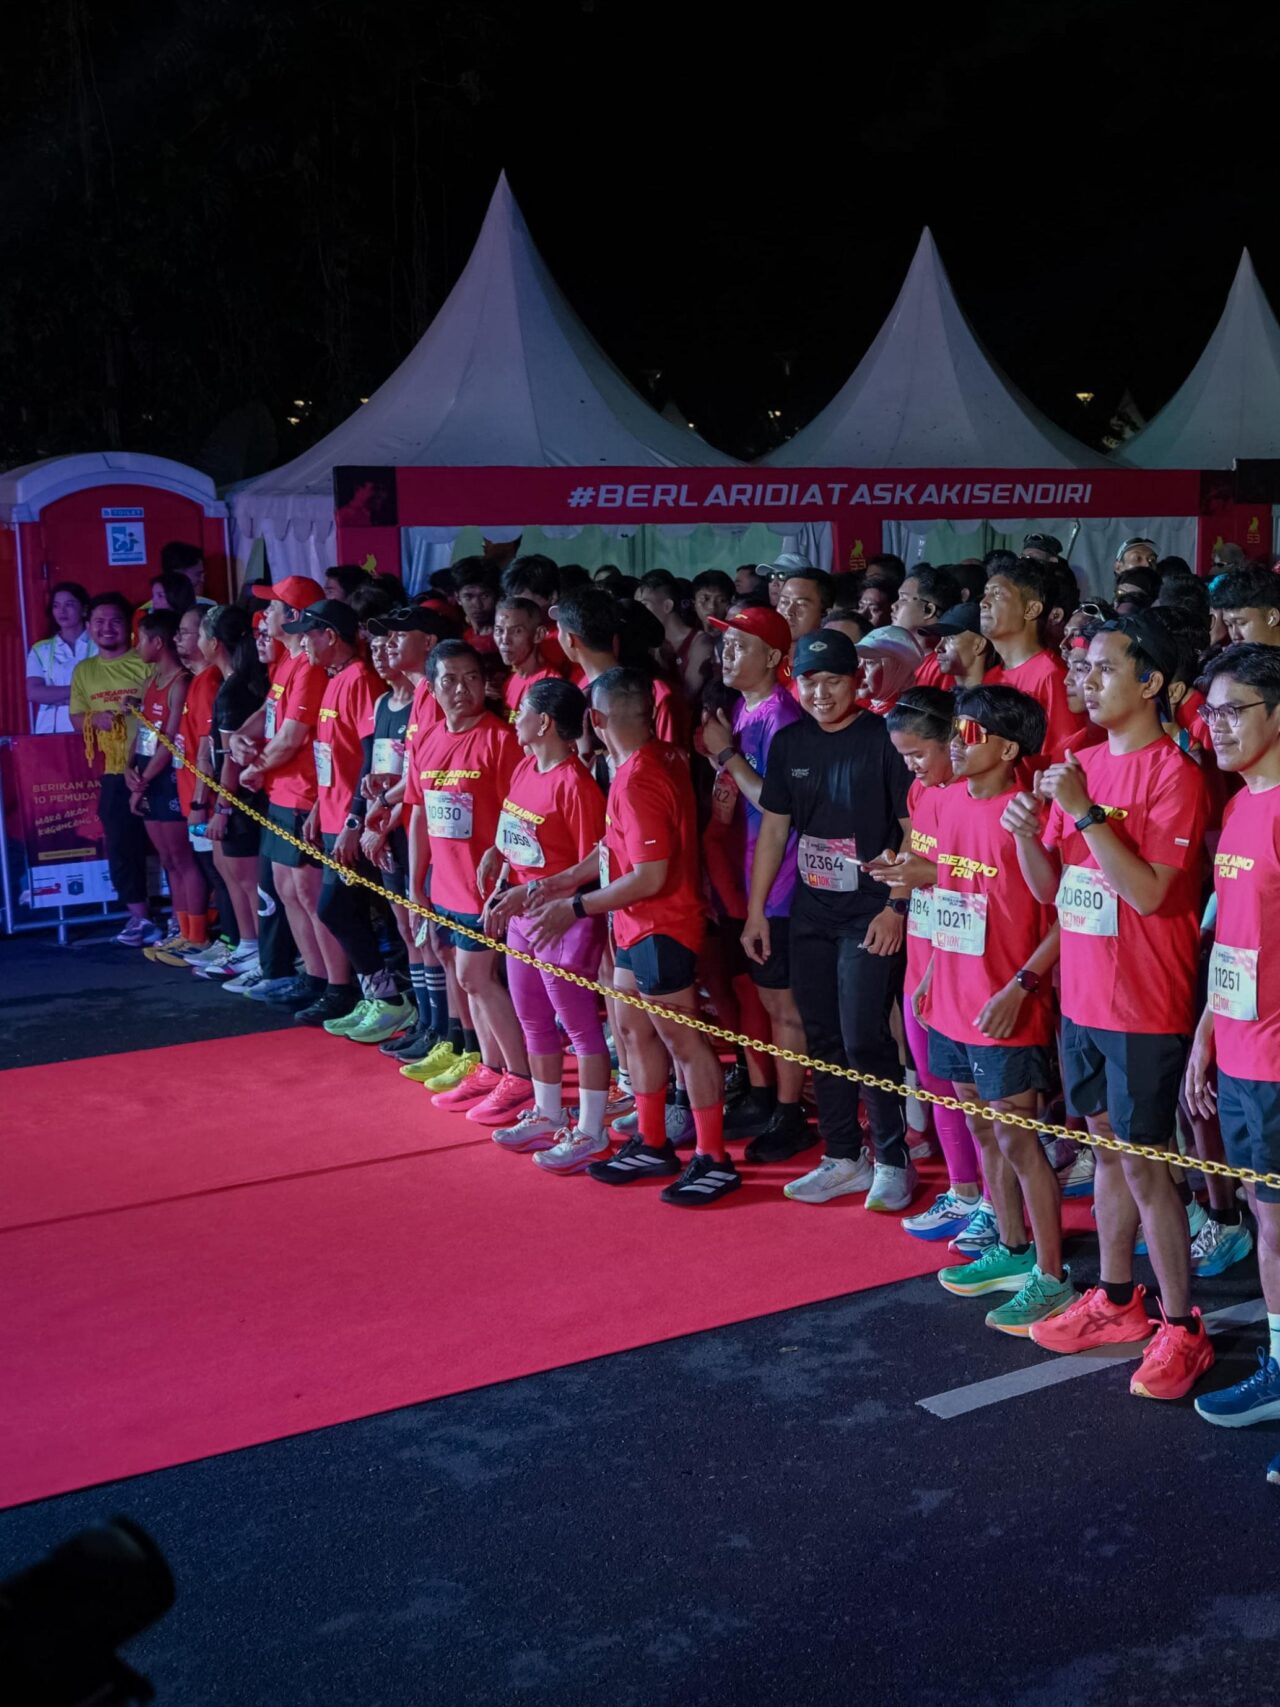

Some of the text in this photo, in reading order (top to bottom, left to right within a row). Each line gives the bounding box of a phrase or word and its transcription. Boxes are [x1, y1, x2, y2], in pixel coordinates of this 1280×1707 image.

[32, 782, 84, 793] BERIKAN
[49, 791, 97, 804] PEMUDA
[428, 805, 462, 821] 10930
[804, 853, 844, 871] 12364
[1061, 885, 1103, 910] 10680
[936, 908, 972, 931] 10211
[1214, 966, 1240, 992] 11251
